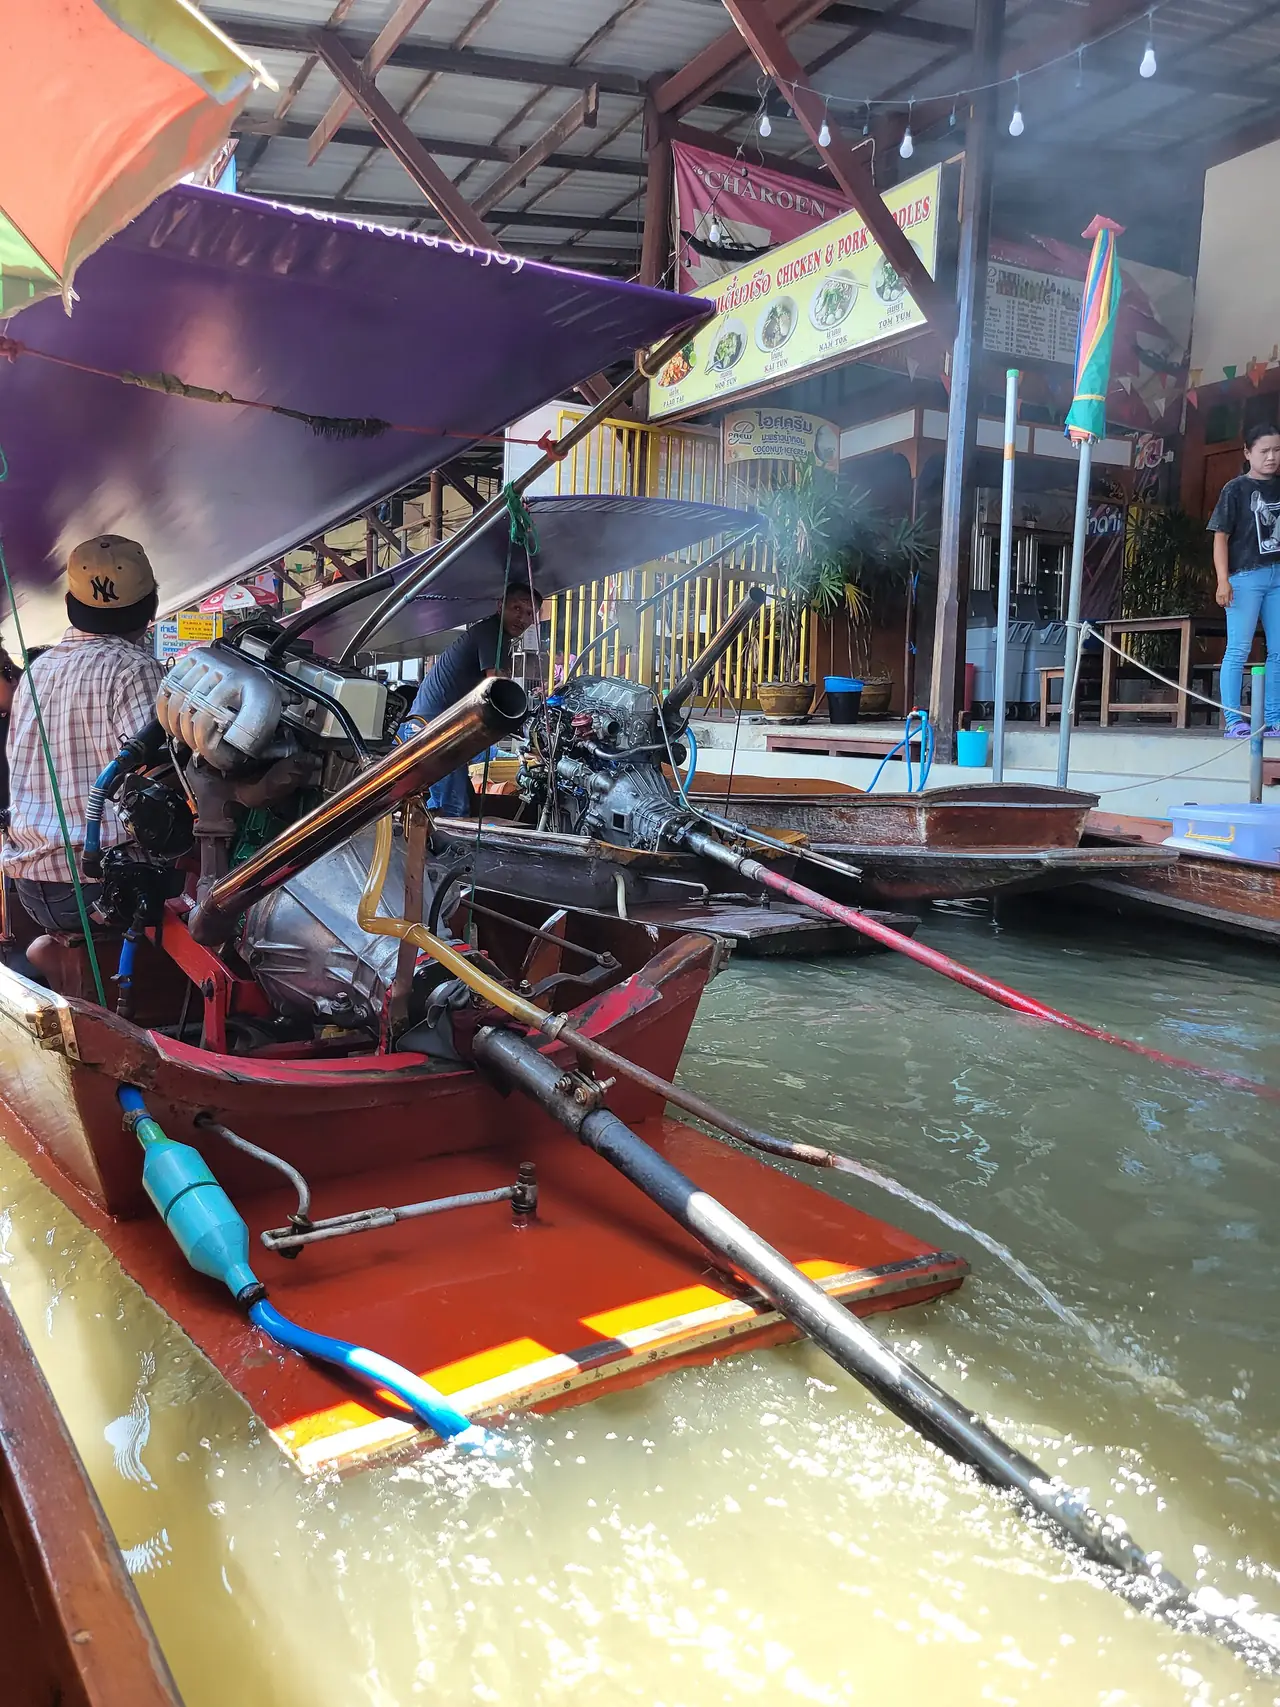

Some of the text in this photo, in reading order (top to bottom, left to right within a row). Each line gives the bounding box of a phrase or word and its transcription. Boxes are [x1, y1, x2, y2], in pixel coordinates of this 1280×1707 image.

[776, 249, 822, 287] CHICKEN
[825, 242, 835, 266] &
[837, 226, 868, 259] PORK
[91, 576, 119, 602] NY
